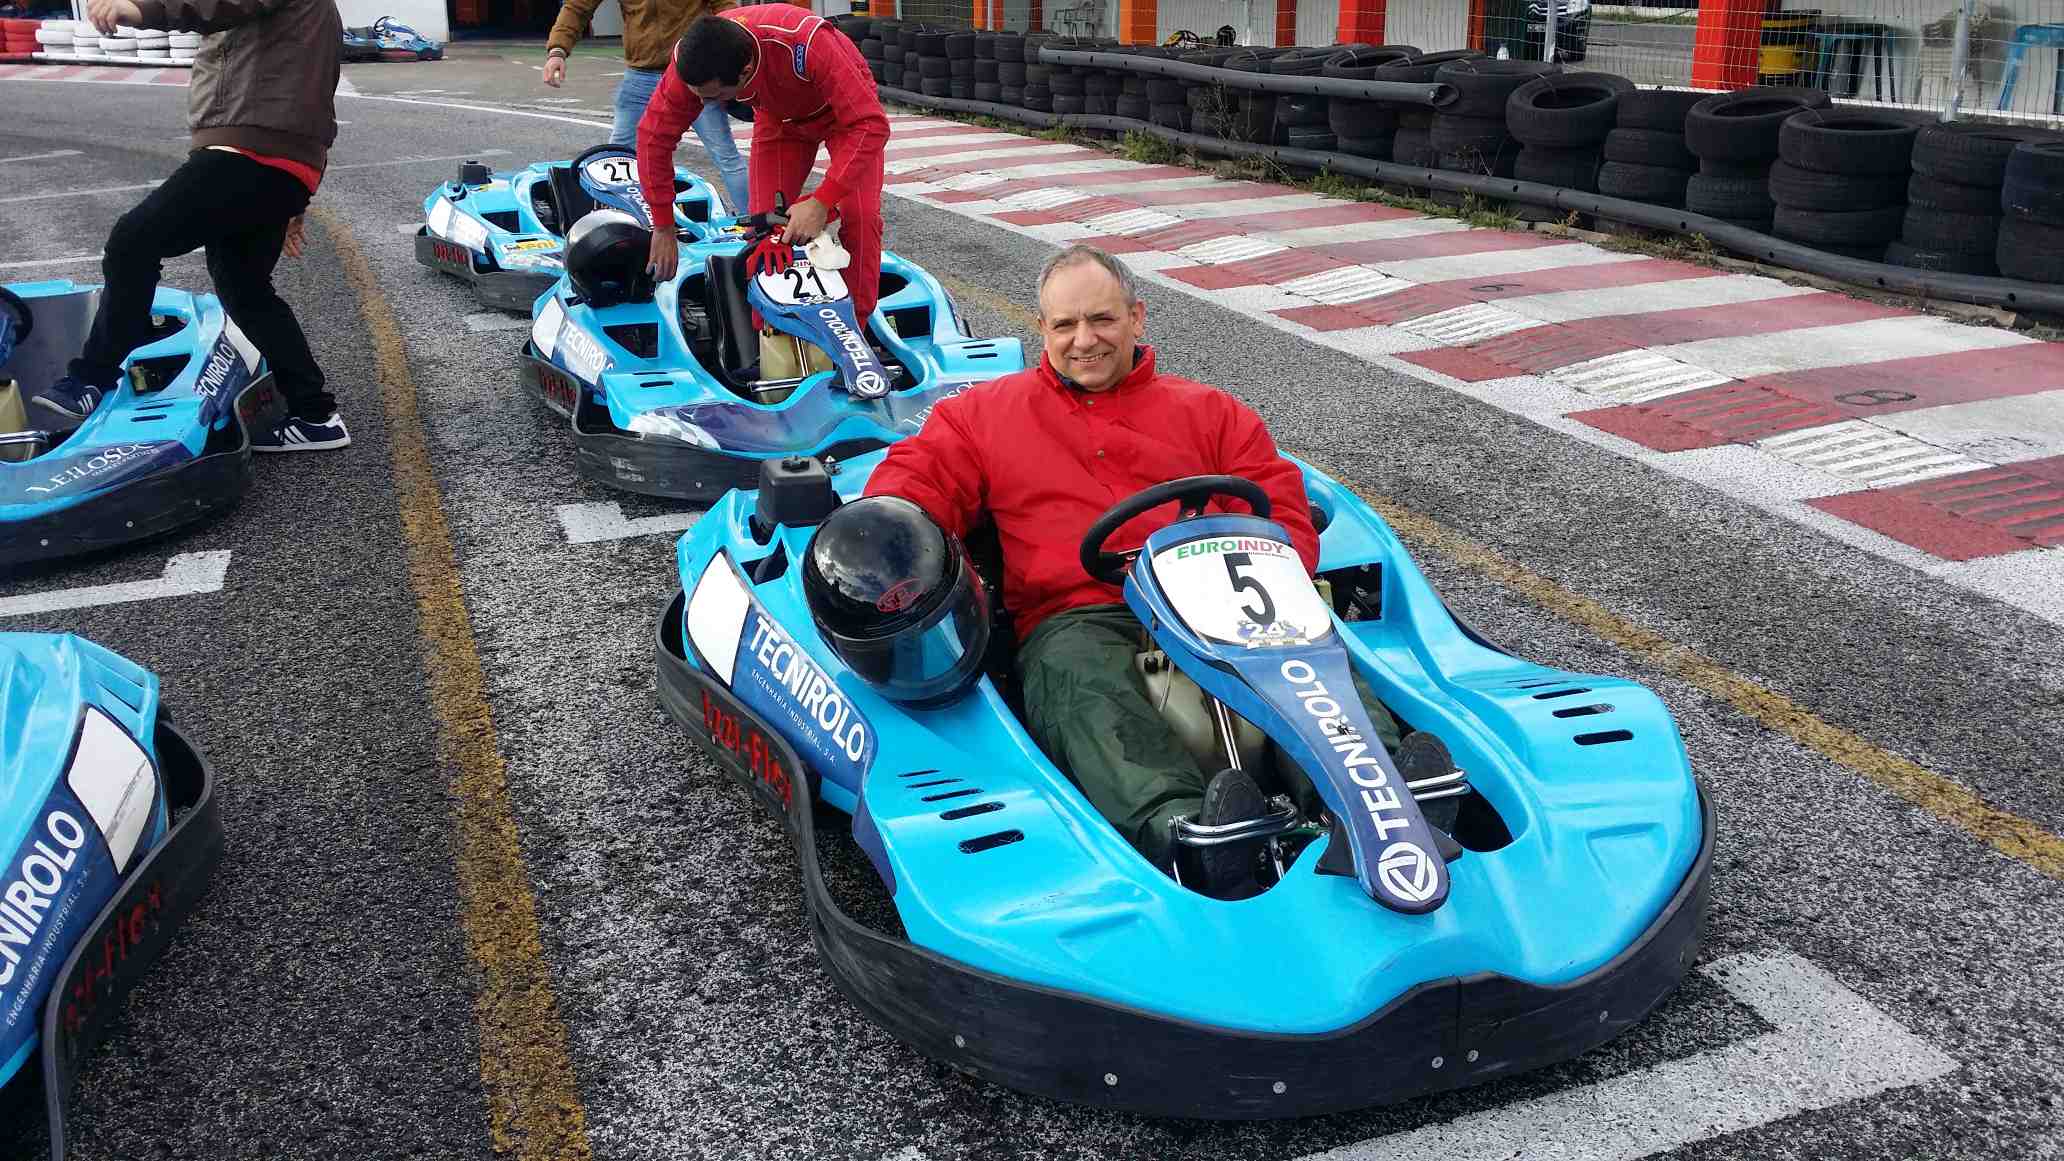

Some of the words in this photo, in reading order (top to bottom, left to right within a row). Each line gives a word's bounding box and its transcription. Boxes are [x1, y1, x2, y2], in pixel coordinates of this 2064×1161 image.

[603, 161, 632, 182] 27
[784, 266, 827, 298] 21
[818, 307, 873, 372] TECNIROLO
[1177, 540, 1284, 560] EUROINDY
[1223, 552, 1276, 625] 5
[751, 615, 865, 763] TECNIROLO
[1280, 659, 1411, 841] TECNIROLO
[7, 954, 46, 1027] ENGENHARIA
